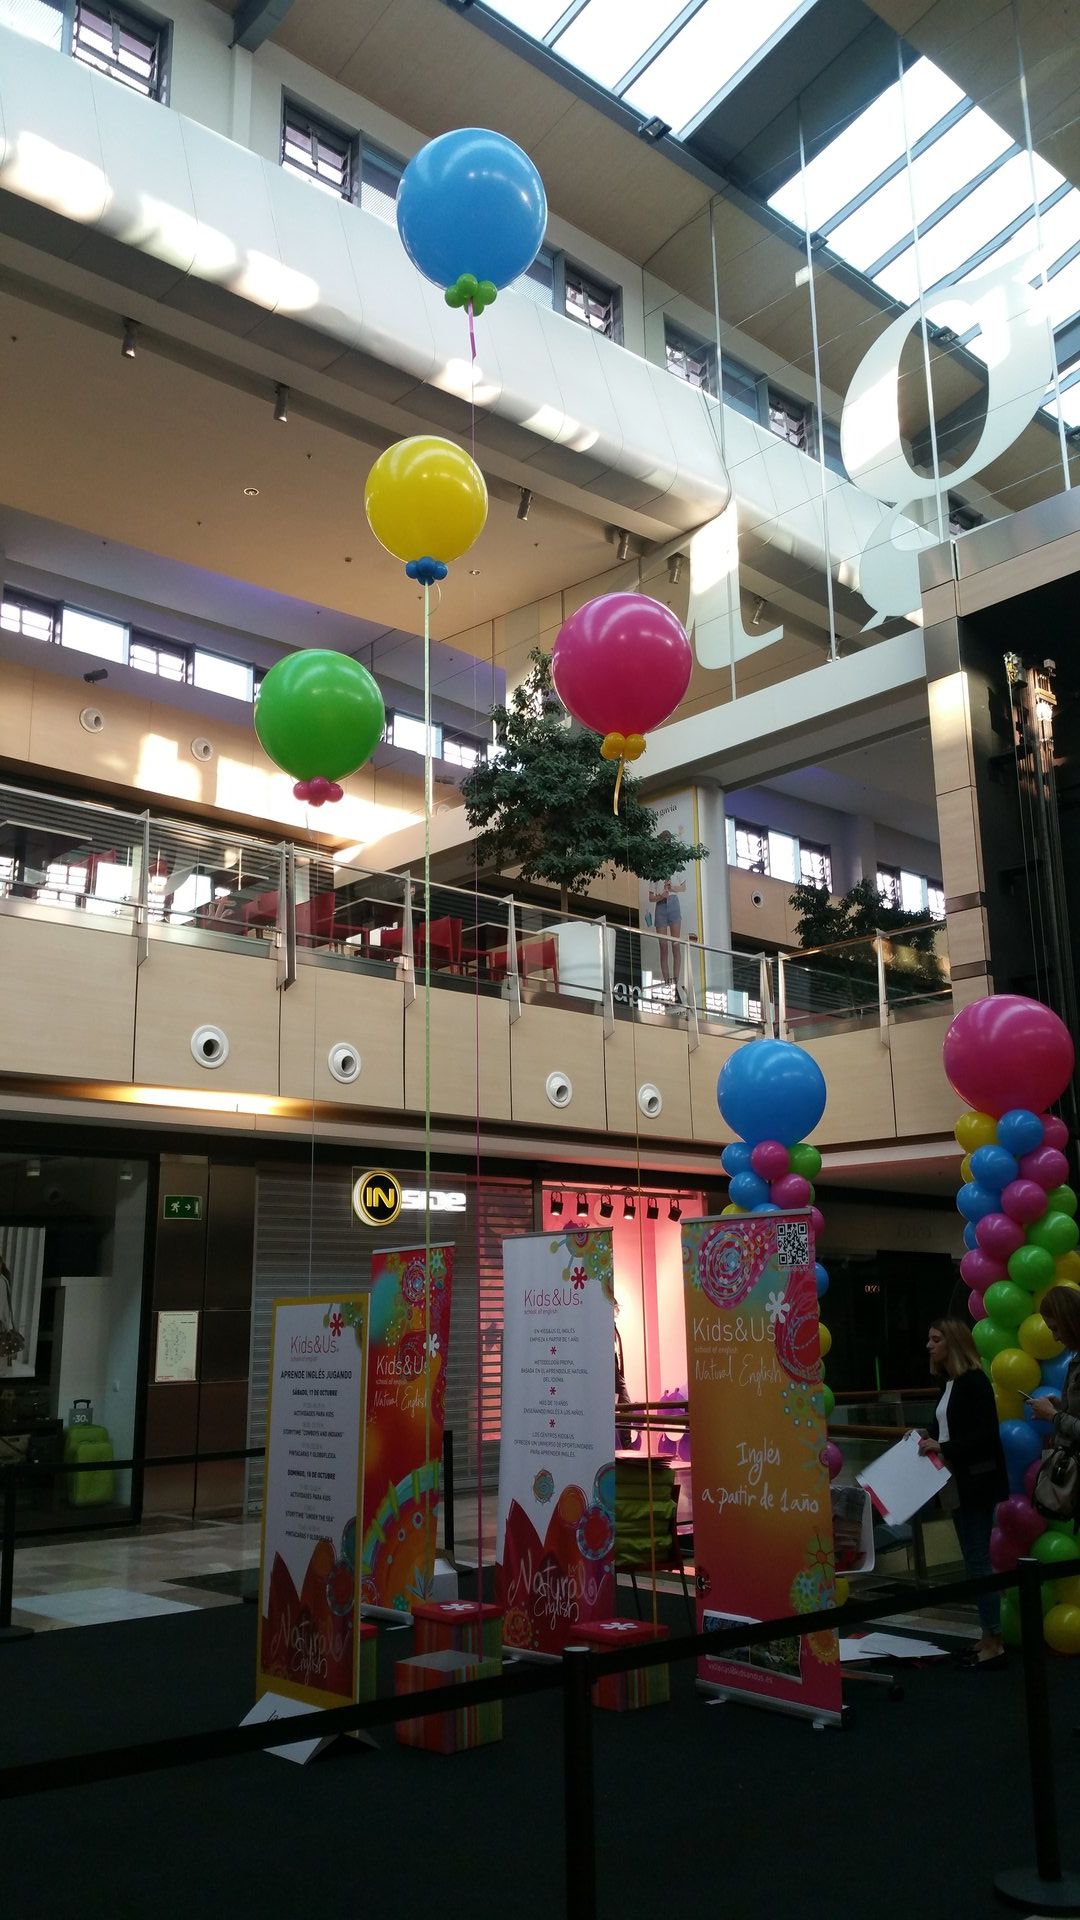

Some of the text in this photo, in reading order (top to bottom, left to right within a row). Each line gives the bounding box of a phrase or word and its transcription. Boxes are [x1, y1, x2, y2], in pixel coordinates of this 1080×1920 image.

[524, 1288, 580, 1307] Kids&Us
[693, 1317, 776, 1342] Kids&Us
[290, 1334, 338, 1354] Kids&Us
[281, 1370, 305, 1380] APRENDE
[326, 1370, 353, 1380] JUGANDO
[695, 1353, 783, 1397] Natural English
[373, 1387, 399, 1408] Natural
[736, 1436, 781, 1486] Inglés
[701, 1487, 715, 1504] a
[716, 1484, 757, 1514] partir
[760, 1482, 775, 1510] de
